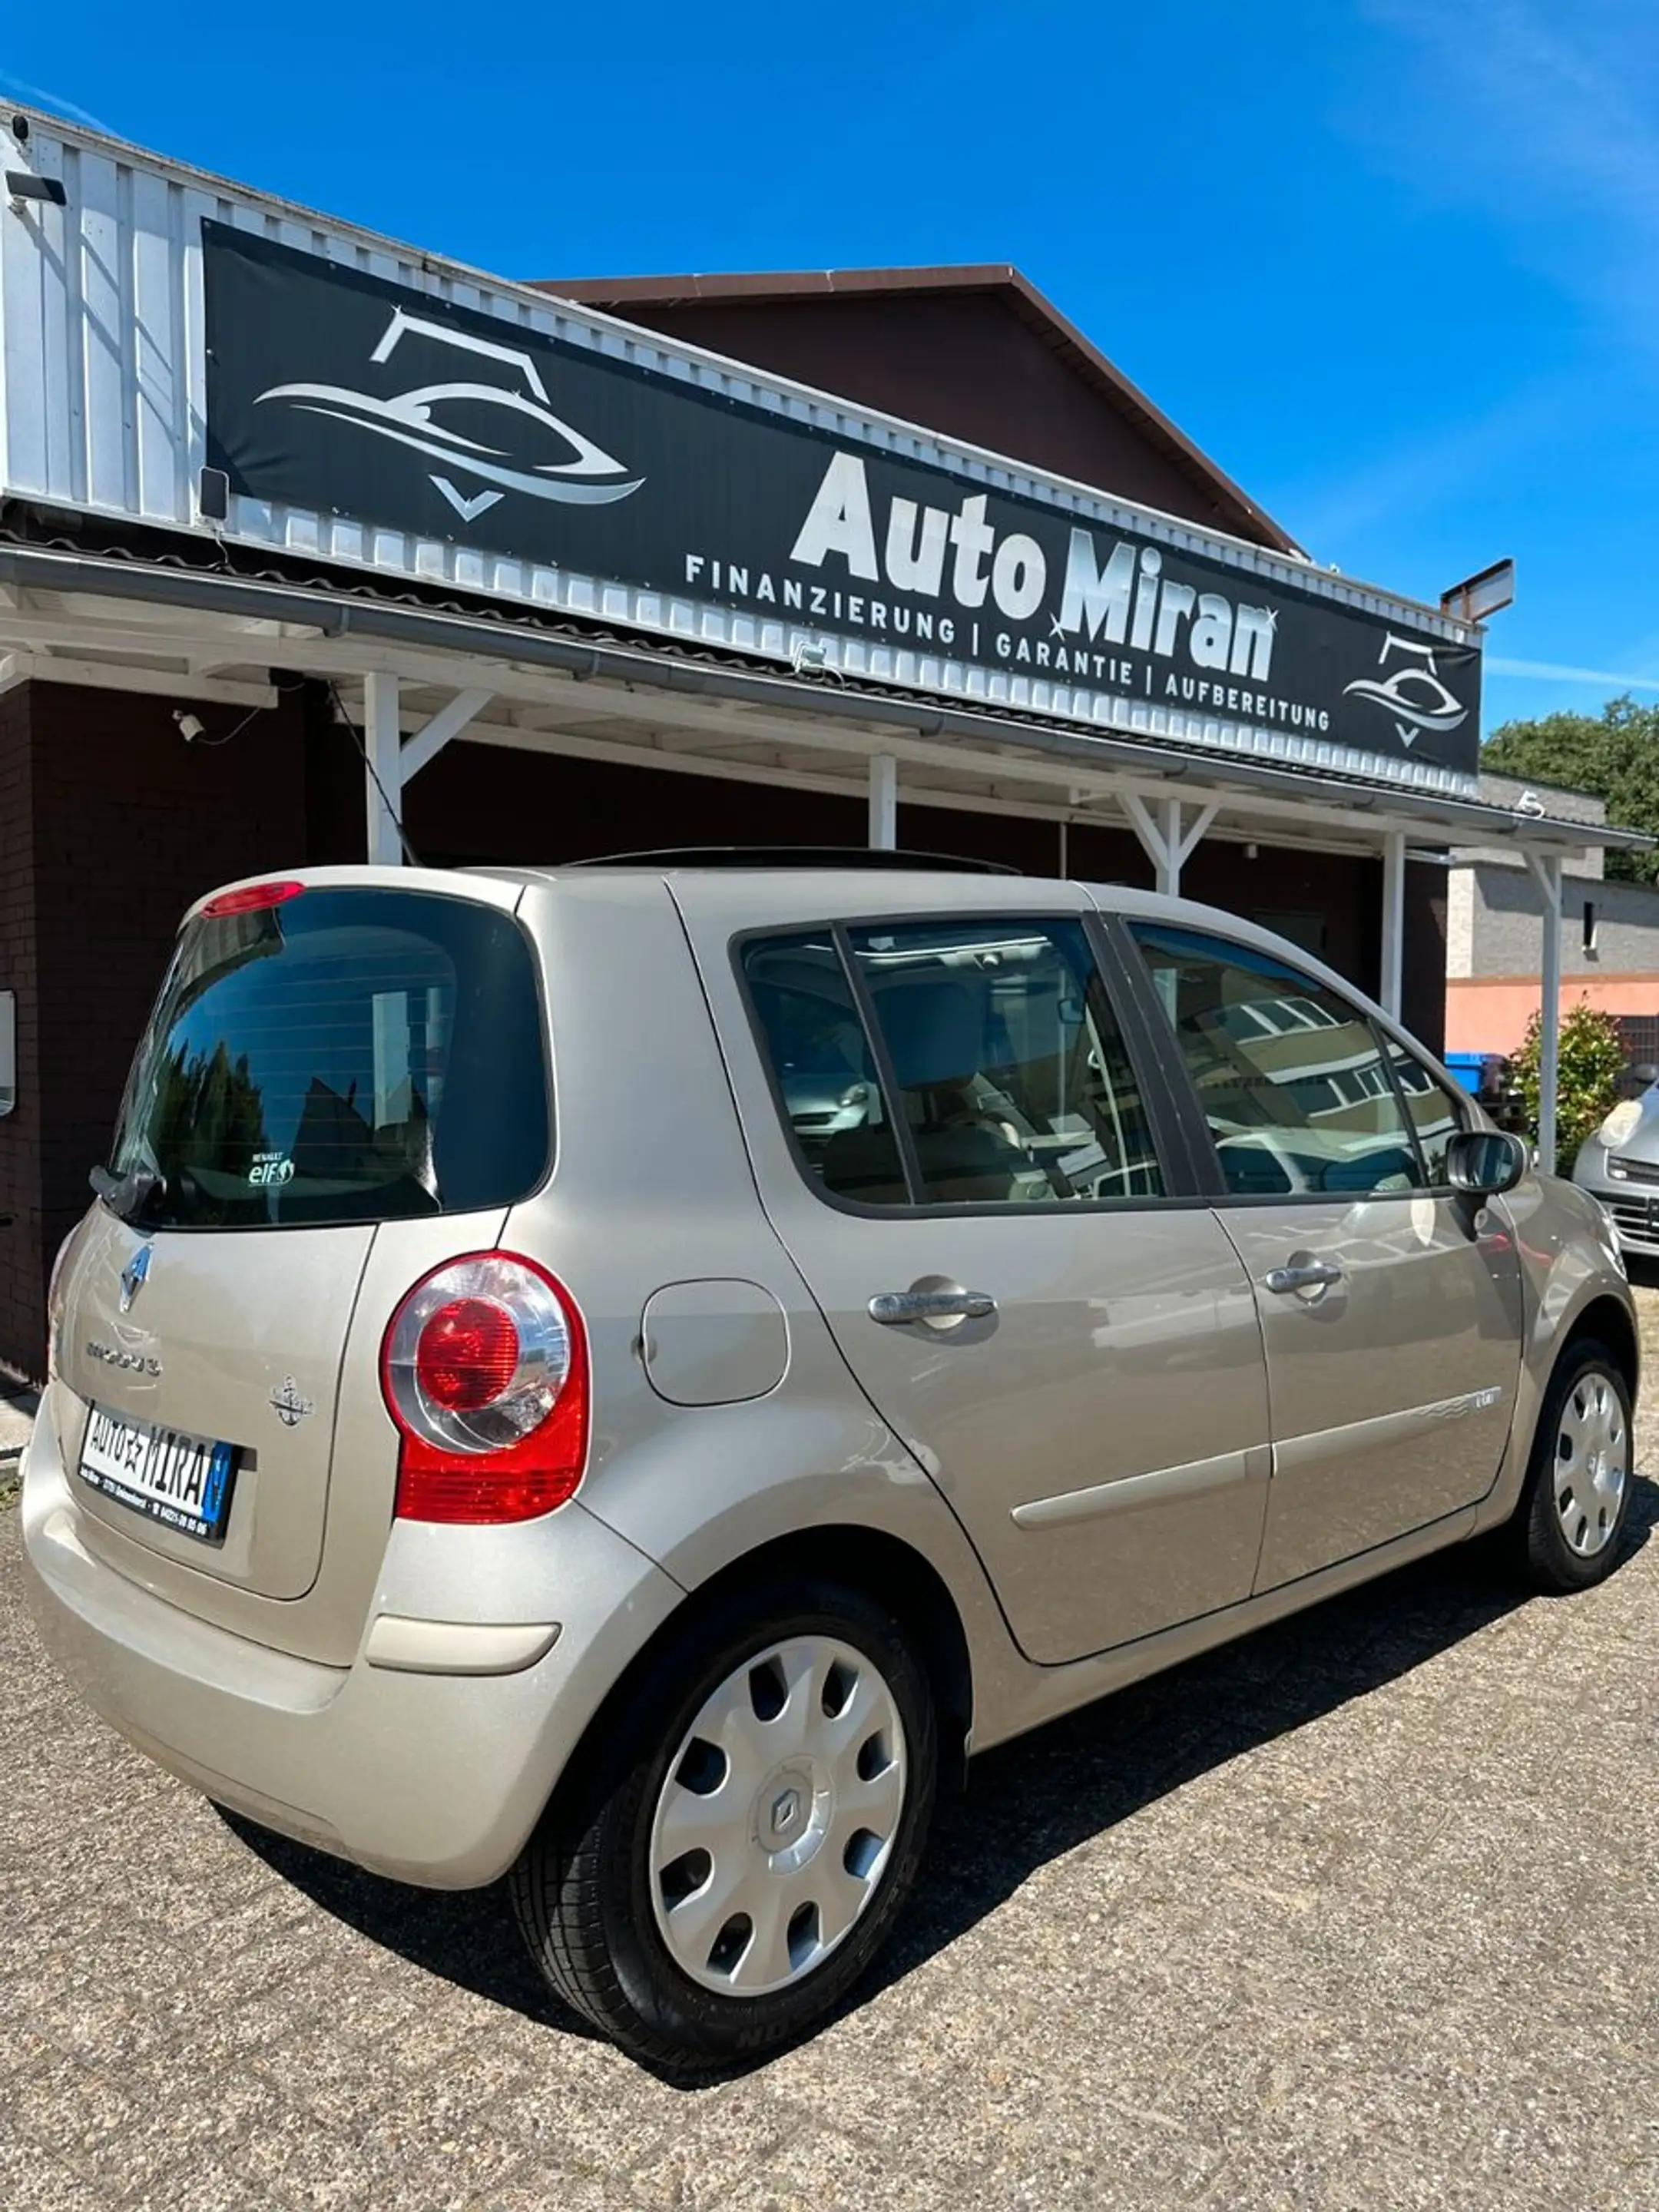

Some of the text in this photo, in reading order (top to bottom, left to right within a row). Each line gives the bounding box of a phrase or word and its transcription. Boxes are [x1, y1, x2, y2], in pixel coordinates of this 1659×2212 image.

[790, 451, 1277, 682] Auto Miran
[685, 554, 1329, 730] FINANZIERUNG GARANTIE AUFBEREITUNG
[249, 1162, 278, 1184] elf
[90, 1415, 126, 1462] AUTO
